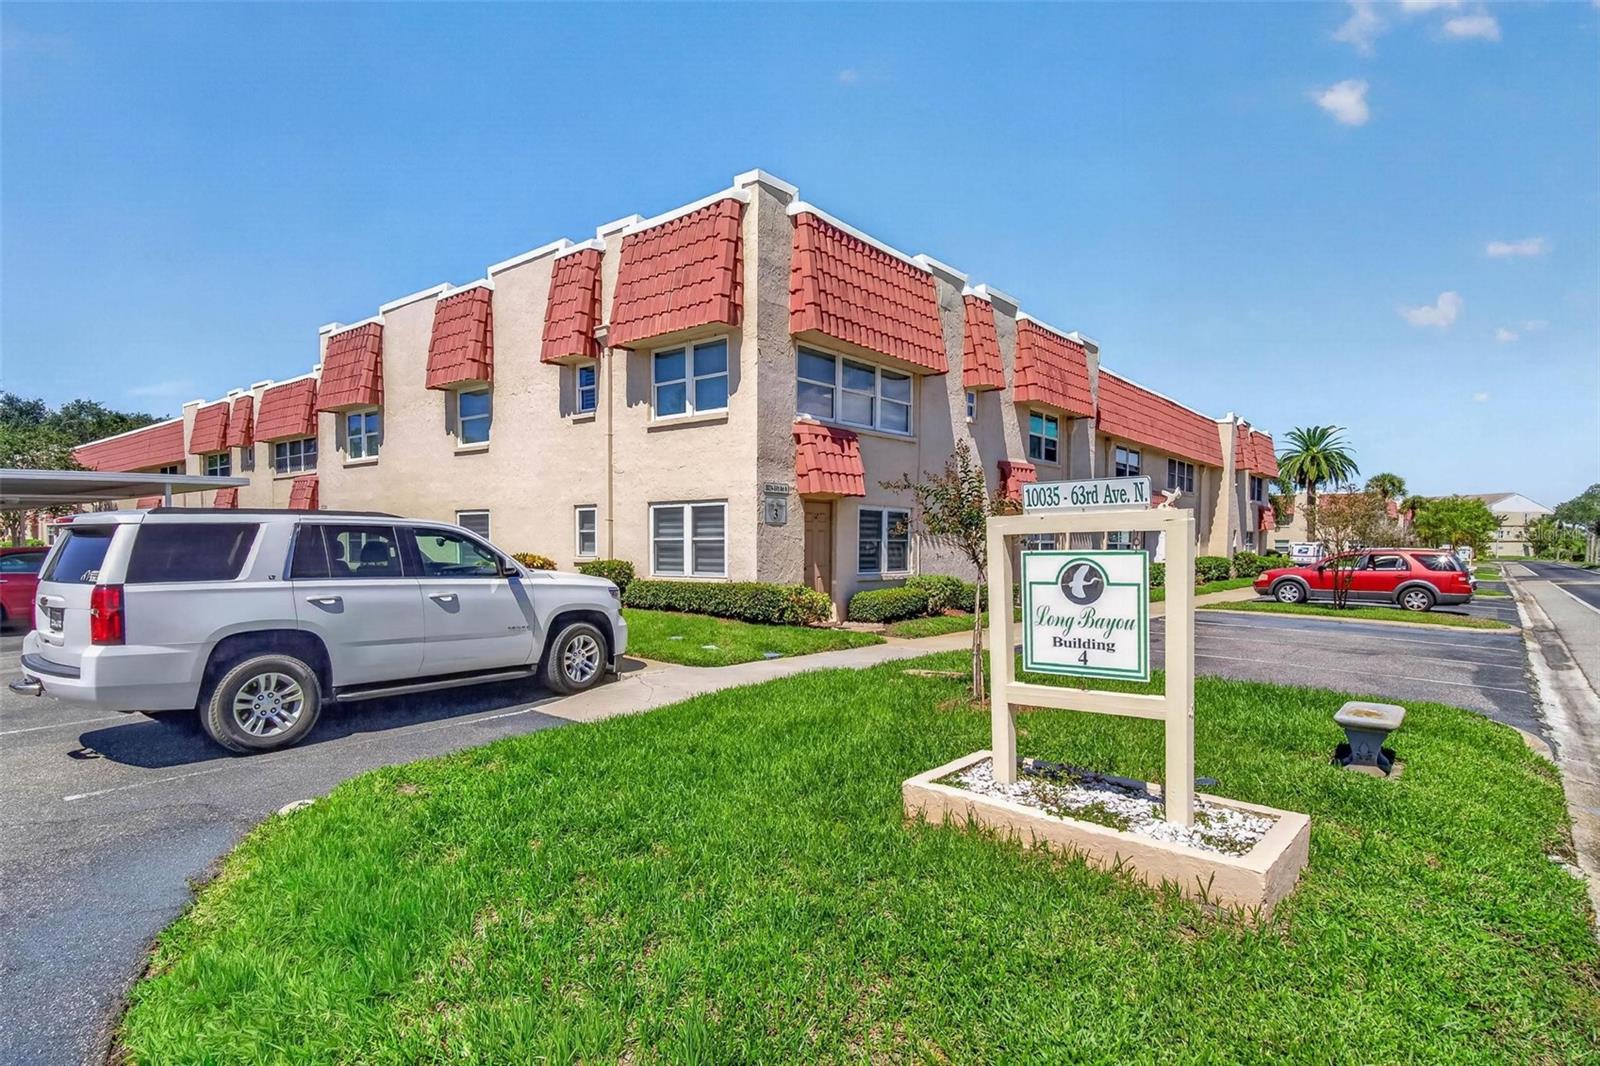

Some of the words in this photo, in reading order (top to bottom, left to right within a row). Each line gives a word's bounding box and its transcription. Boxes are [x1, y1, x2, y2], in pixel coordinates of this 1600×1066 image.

[1025, 486, 1060, 507] 10035
[1071, 484, 1099, 505] 63rd
[1103, 483, 1130, 504] Ave.
[1133, 481, 1148, 503] N.
[1035, 604, 1075, 637] Long
[1077, 606, 1136, 639] Bayou
[1052, 636, 1116, 653] Building
[1078, 650, 1088, 666] 4
